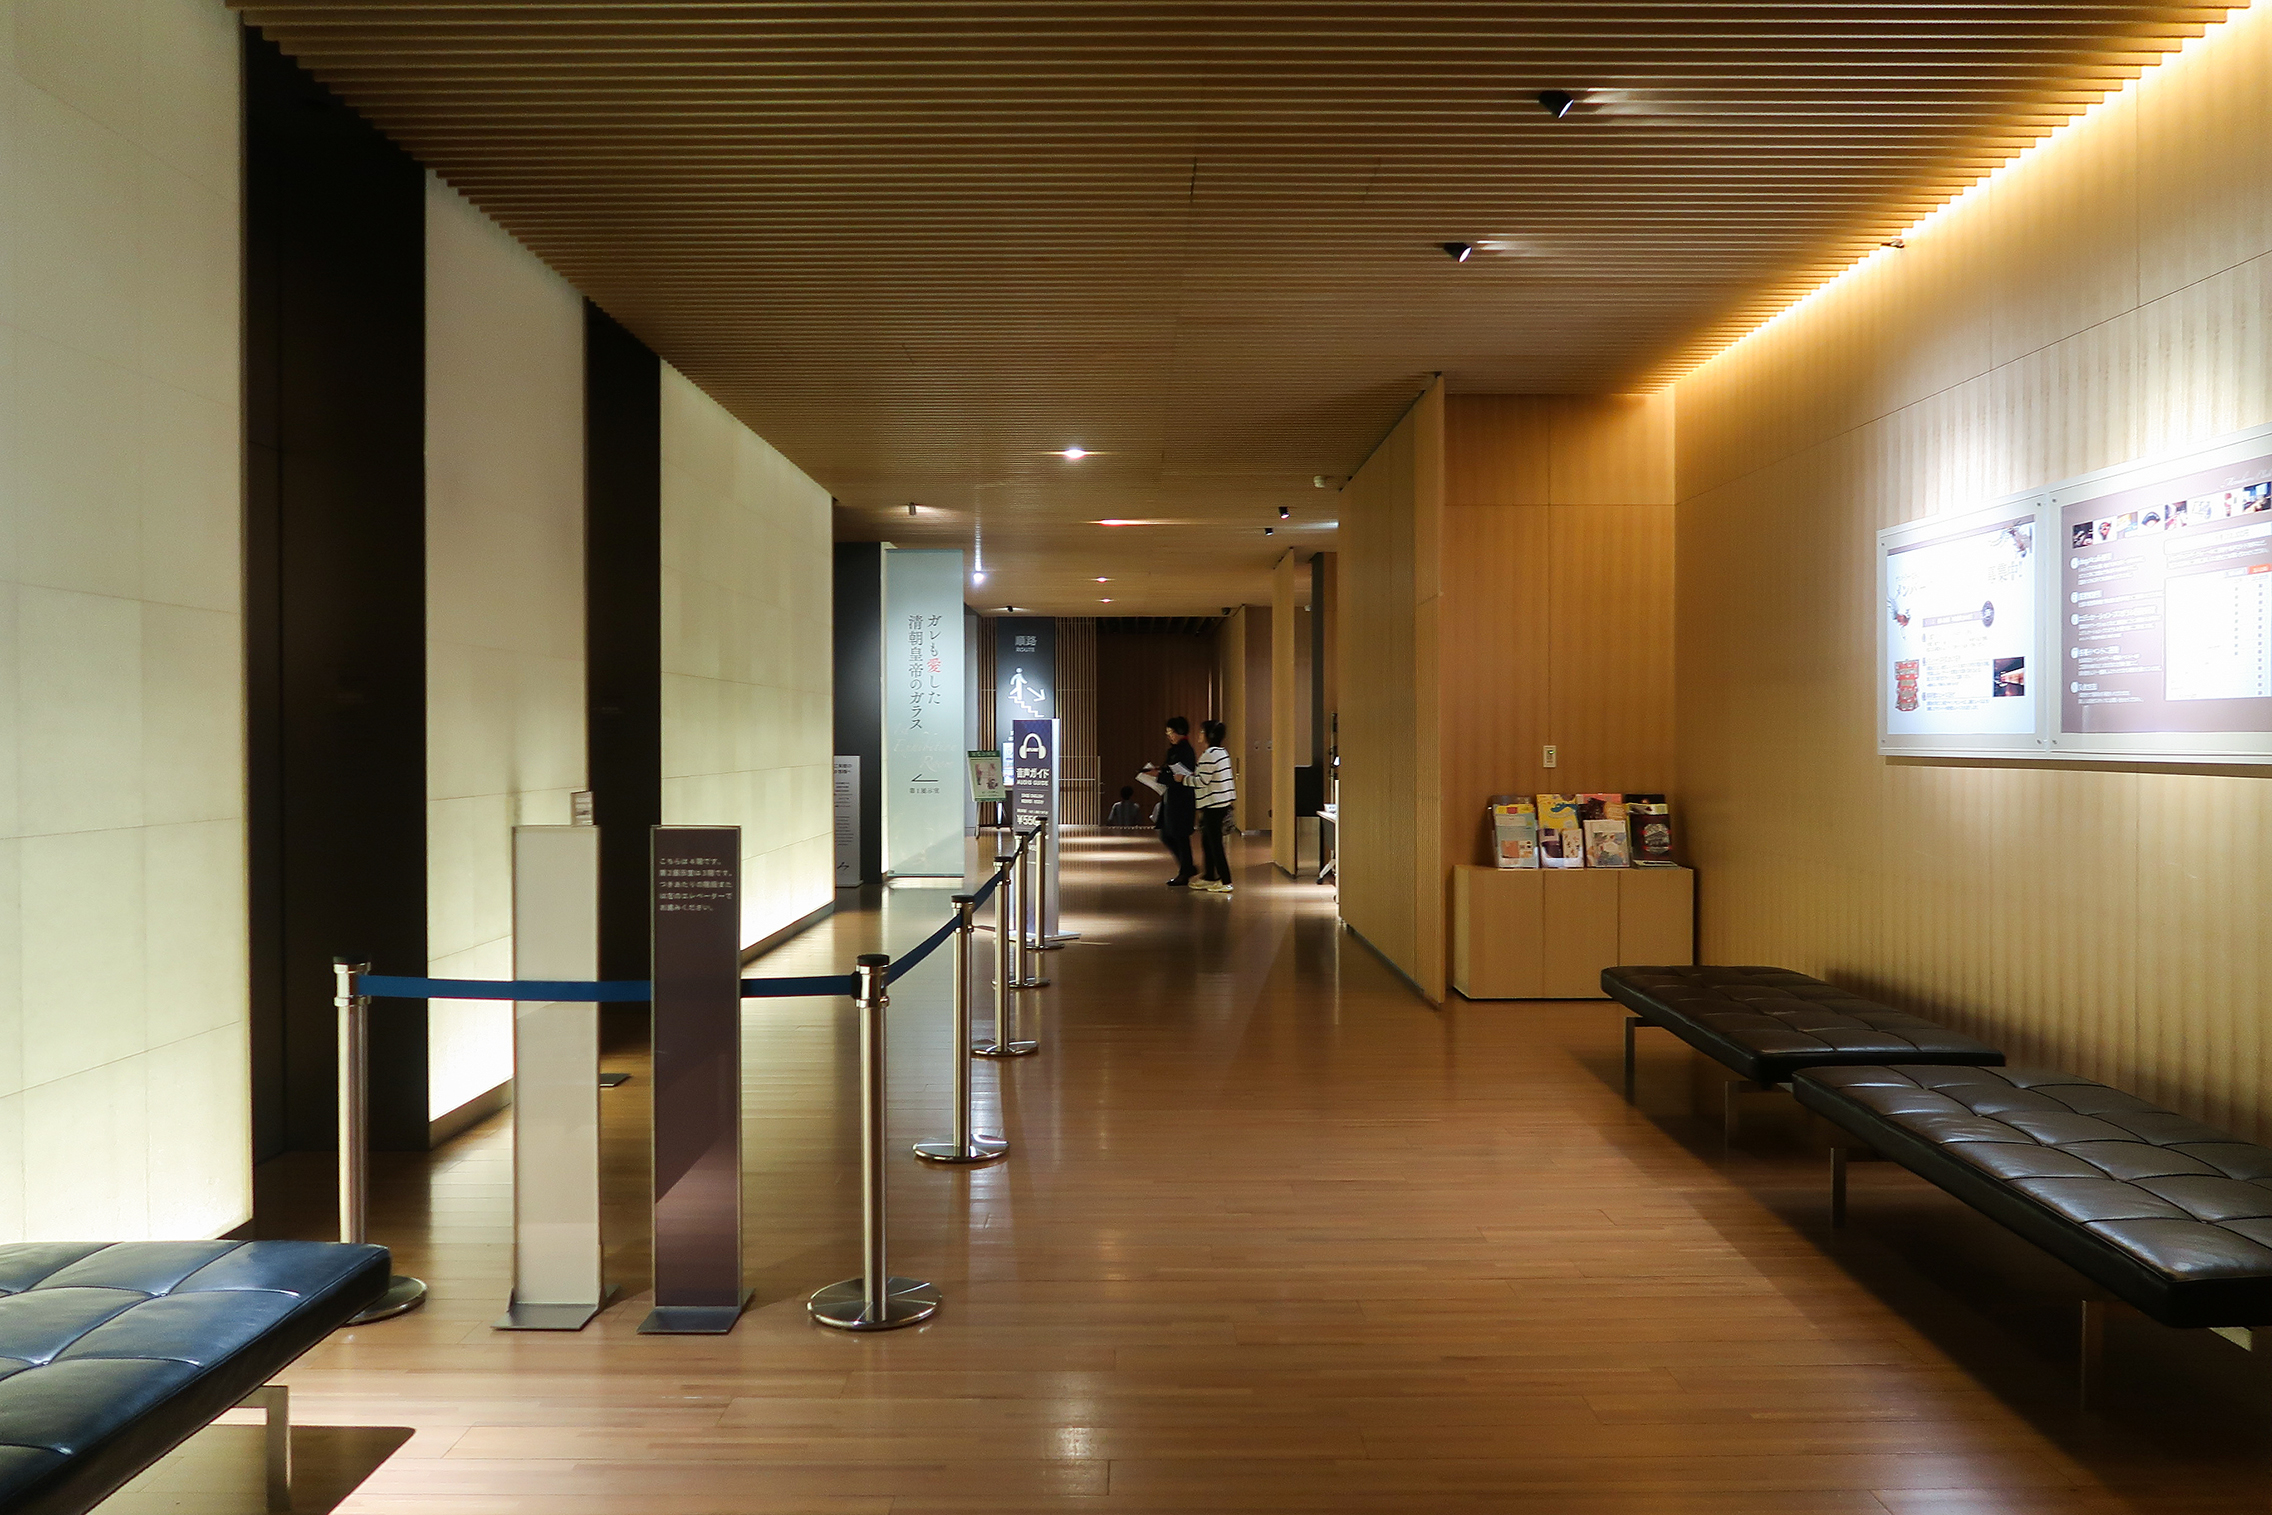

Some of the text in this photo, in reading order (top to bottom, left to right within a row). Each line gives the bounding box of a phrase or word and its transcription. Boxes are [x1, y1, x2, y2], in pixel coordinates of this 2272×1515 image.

[927, 614, 942, 704] ガレも愛した
[1015, 635, 1037, 647] 順路
[908, 614, 924, 730] 清朝皇帝のガラス
[1016, 767, 1050, 779] 音声ガイド
